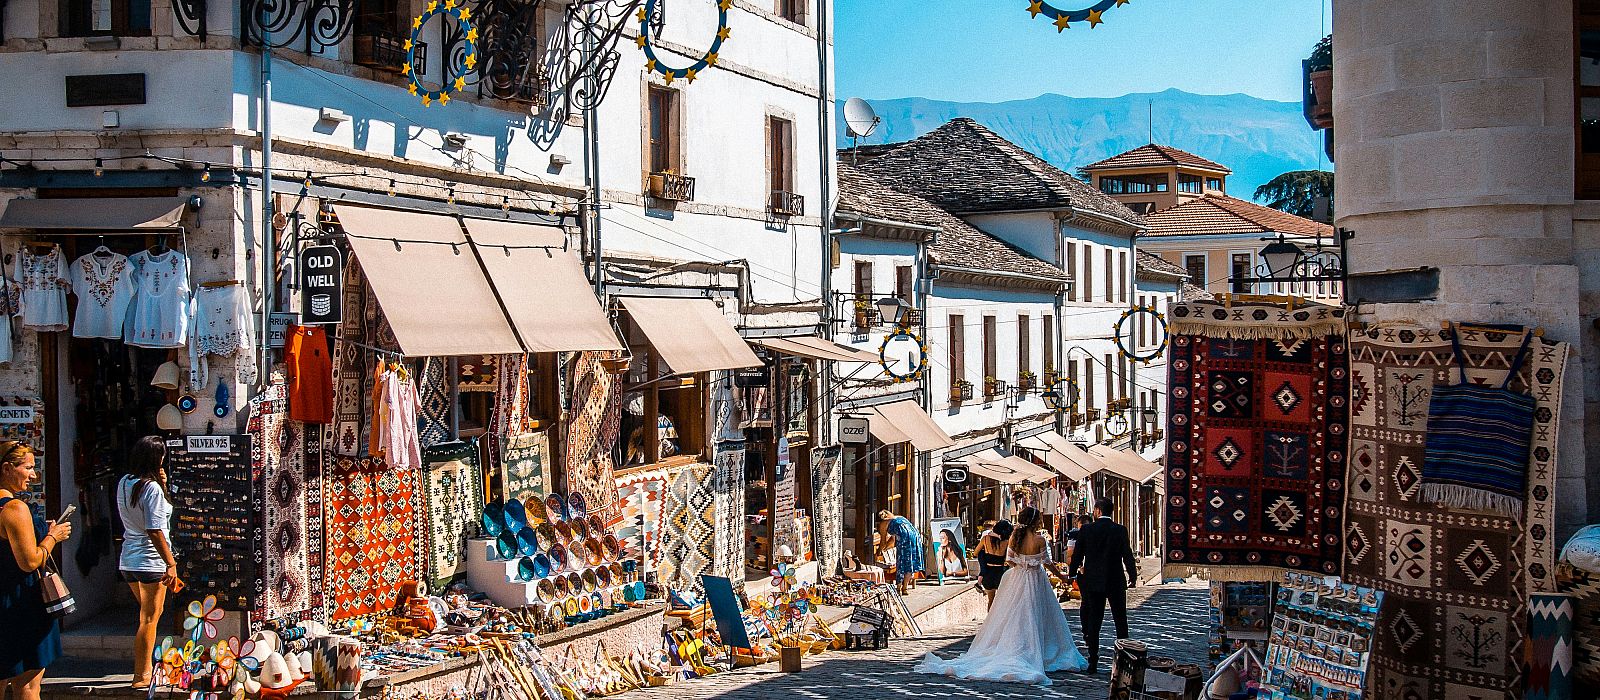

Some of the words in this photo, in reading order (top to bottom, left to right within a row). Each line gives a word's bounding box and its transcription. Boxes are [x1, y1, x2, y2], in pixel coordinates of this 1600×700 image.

[308, 255, 334, 269] OLD
[307, 274, 335, 288] WELL
[0, 409, 30, 419] GNETS
[190, 438, 214, 448] SILVER
[215, 438, 228, 448] 925
